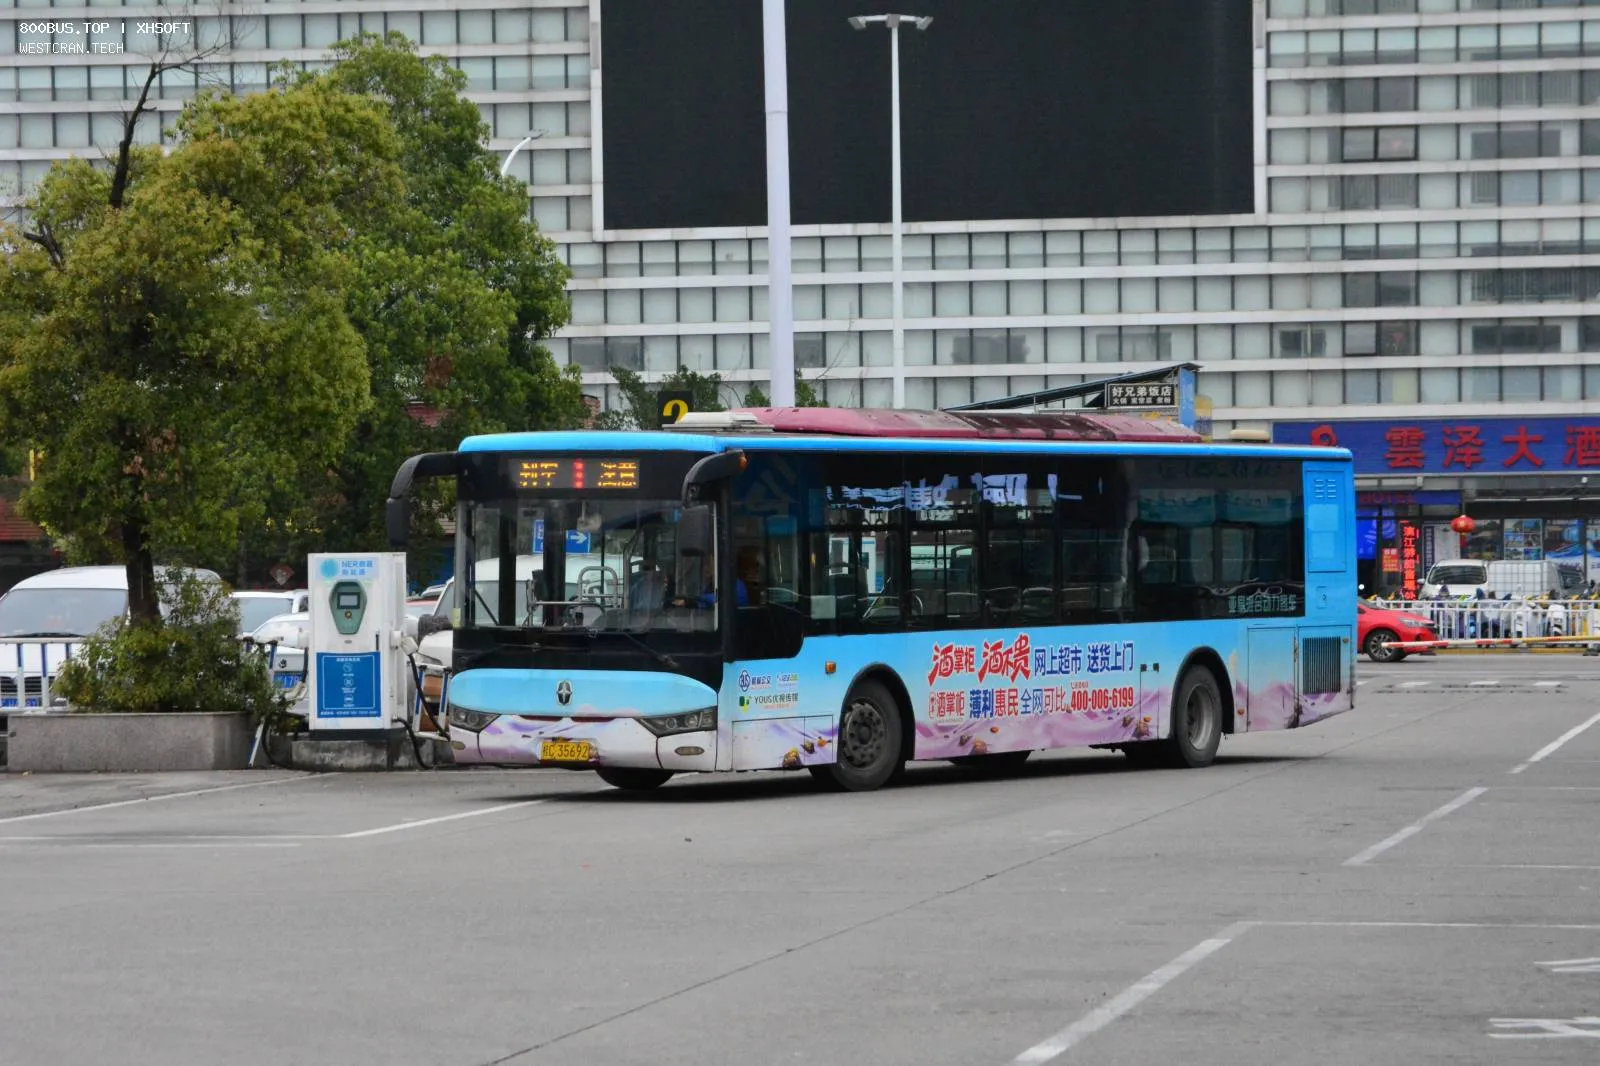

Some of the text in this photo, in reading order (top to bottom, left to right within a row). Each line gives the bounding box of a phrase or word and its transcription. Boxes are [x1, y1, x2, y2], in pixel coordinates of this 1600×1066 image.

[1112, 386, 1172, 397] 好兄弟饭店
[573, 460, 585, 489] 1
[928, 634, 1134, 685] 酒掌柜 酒不贵 网上超市 送货上门
[969, 688, 1019, 719] 薄利惠民
